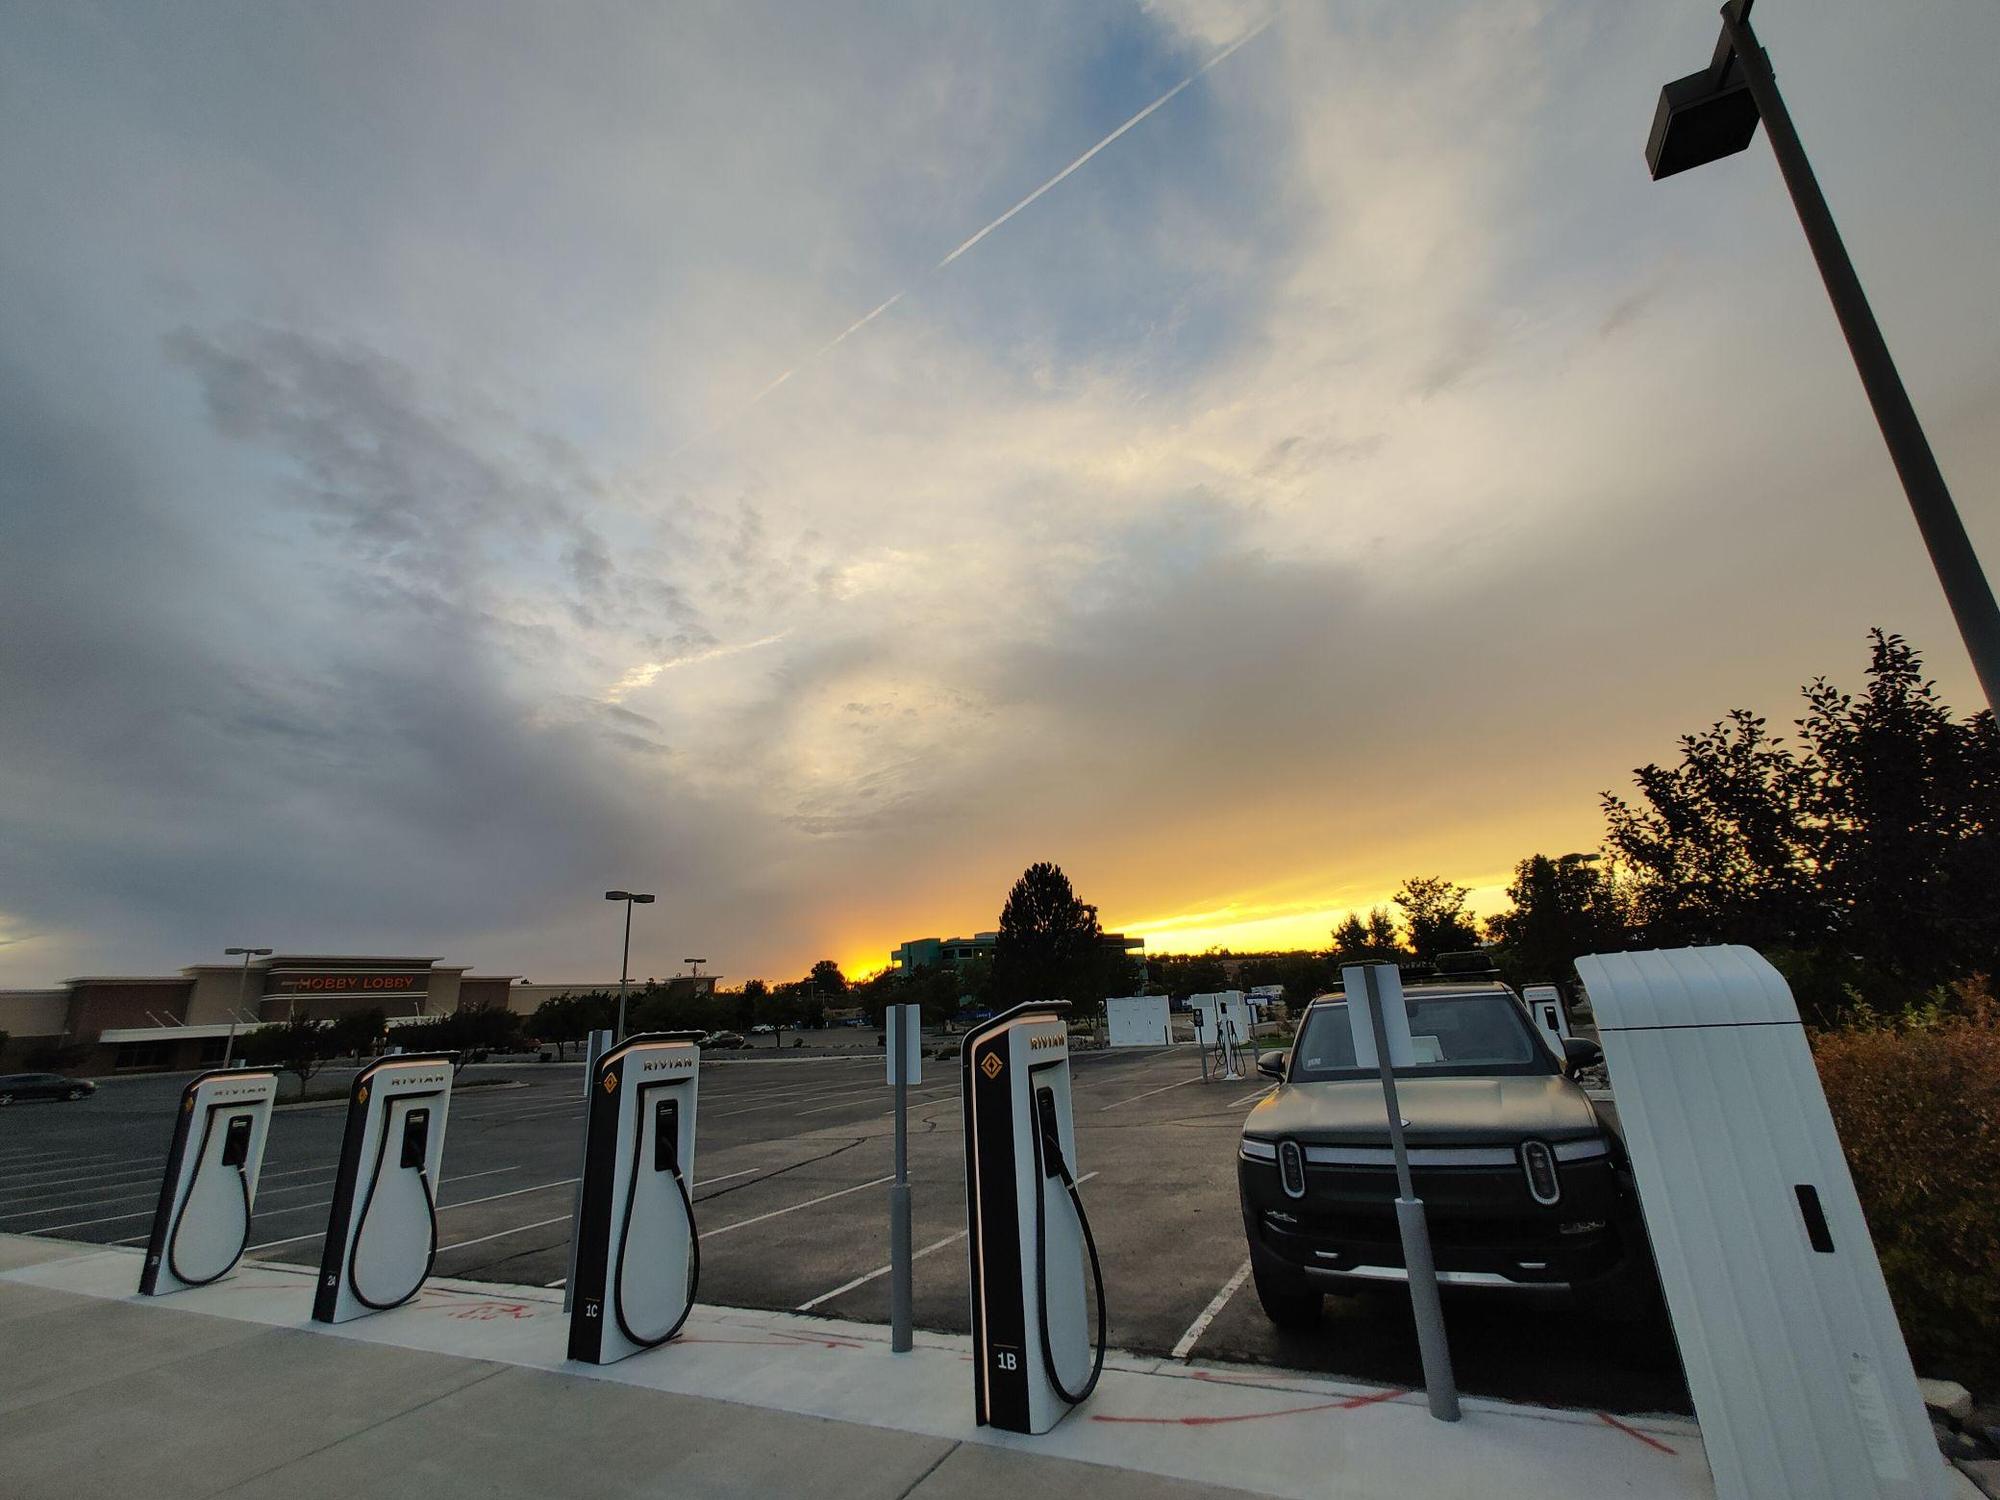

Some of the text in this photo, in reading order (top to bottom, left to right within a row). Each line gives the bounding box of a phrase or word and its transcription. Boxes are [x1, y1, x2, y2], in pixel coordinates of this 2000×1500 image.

[299, 977, 413, 989] HOBBY LOBBY
[1031, 1034, 1065, 1050] RIVIAN
[644, 1057, 693, 1071] RIVIAN
[391, 1074, 444, 1085] RIVIAN
[214, 1086, 267, 1096] RIVIAN
[585, 1303, 598, 1317] 1C
[997, 1352, 1017, 1370] 1B
